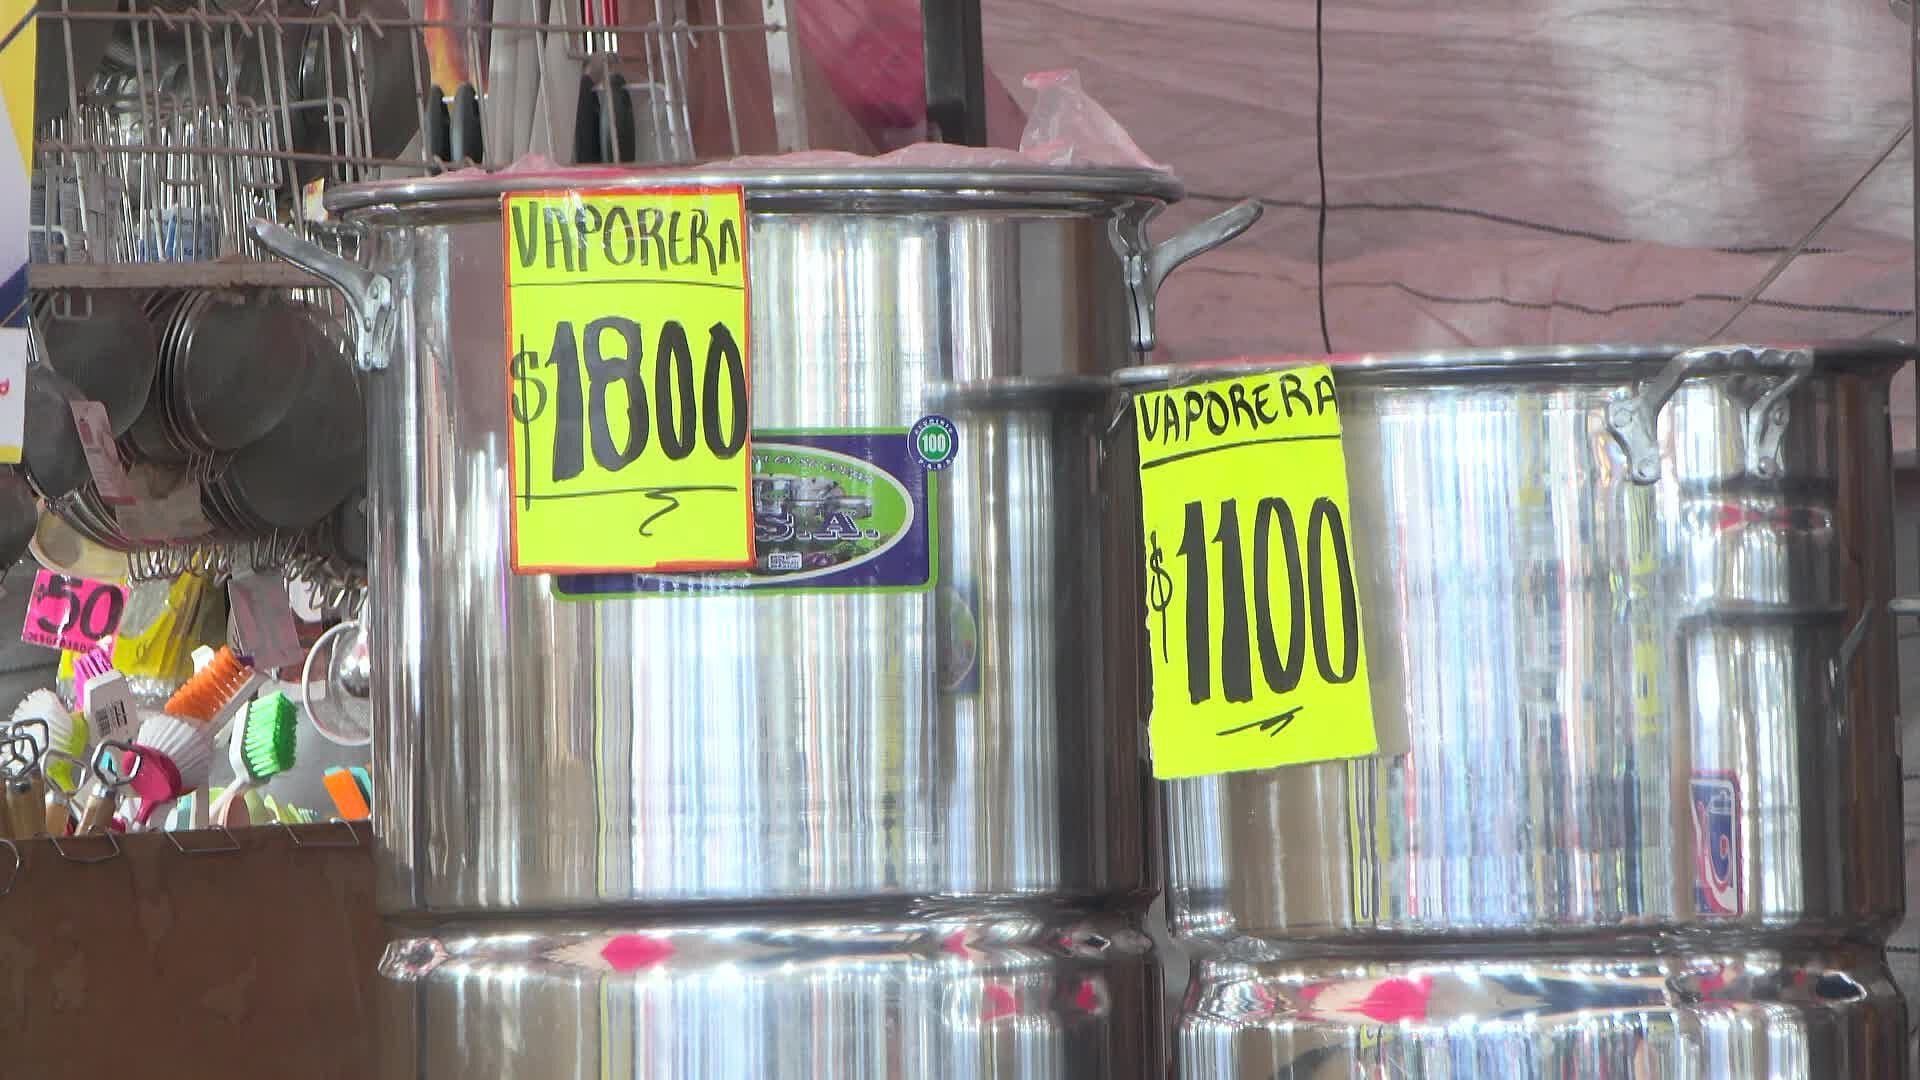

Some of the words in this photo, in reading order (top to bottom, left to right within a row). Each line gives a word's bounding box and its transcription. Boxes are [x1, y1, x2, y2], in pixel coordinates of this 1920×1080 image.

[512, 201, 740, 275] VAPORERA
[510, 316, 749, 510] $1800
[921, 432, 946, 453] 100
[1139, 373, 1338, 445] VAPORERA
[1150, 497, 1359, 705] $1100
